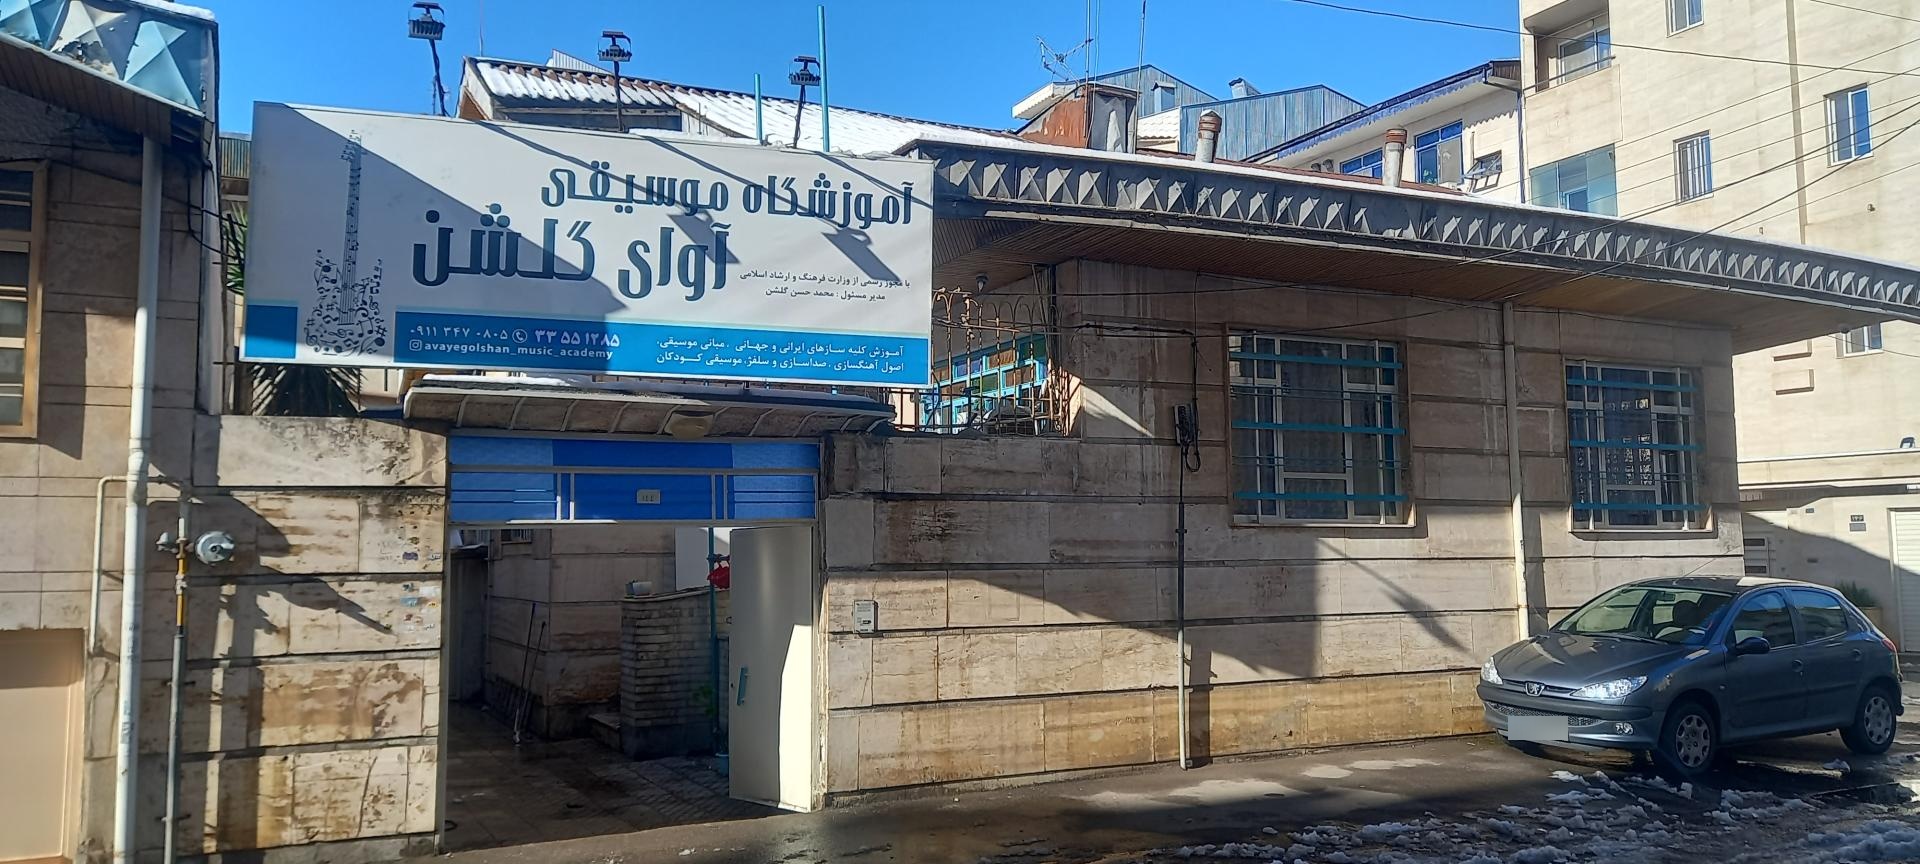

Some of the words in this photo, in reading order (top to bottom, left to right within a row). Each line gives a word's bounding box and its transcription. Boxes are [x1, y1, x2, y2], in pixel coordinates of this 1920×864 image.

[541, 160, 729, 216] موسیقی
[742, 172, 913, 230] آموزشگاه
[412, 203, 595, 287] گلشن
[617, 221, 732, 301] آوای
[739, 269, 768, 280] اسلامی
[769, 272, 790, 282] ارشاد
[792, 274, 797, 282] و
[799, 274, 826, 285] فرهنگ
[828, 274, 851, 286] وزارت
[853, 276, 859, 286] از
[861, 279, 883, 288] رسمی
[884, 280, 903, 290] مجوز
[904, 279, 911, 290] با
[765, 286, 789, 297] گلشن
[790, 288, 811, 298] حسن
[813, 289, 834, 297] محمد
[841, 289, 867, 300] مسئول
[868, 293, 886, 302] مدیر
[424, 341, 613, 360] avayegolshan_music_academy
[700, 338, 725, 352] مبانی
[735, 340, 769, 352] جهانی
[771, 344, 777, 353] و
[779, 341, 805, 354] ایرانی
[807, 342, 846, 356] سازهای
[848, 345, 867, 356] کلیه
[868, 345, 904, 358] آموزش
[656, 351, 703, 364] کودکان
[705, 353, 743, 367] موسیقی
[771, 360, 777, 369] و
[833, 358, 879, 371] آهنگسازی
[881, 361, 904, 374] اصول
